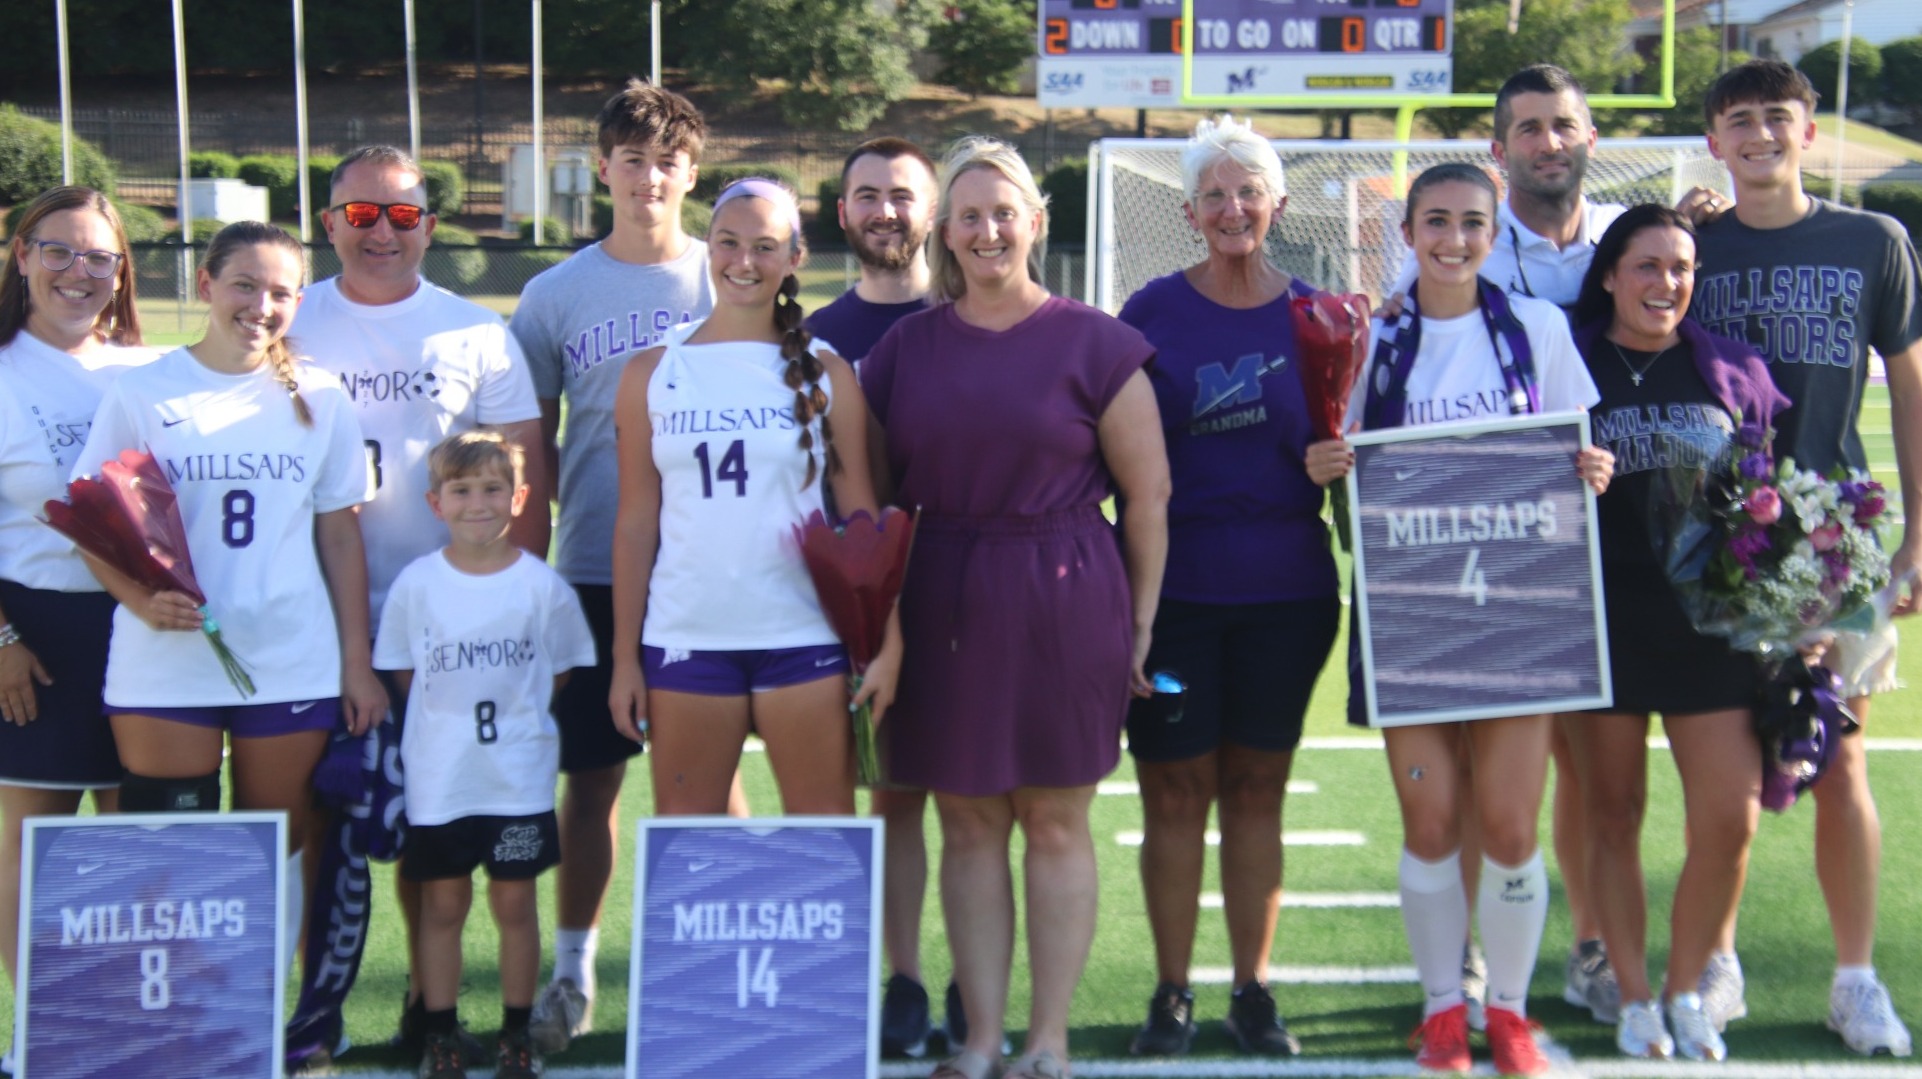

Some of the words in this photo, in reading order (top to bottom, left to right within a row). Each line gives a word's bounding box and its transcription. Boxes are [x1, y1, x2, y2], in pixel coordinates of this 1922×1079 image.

[1046, 19, 1068, 54] 2
[1071, 20, 1140, 49] DOWN
[1197, 19, 1230, 49] TO
[1237, 19, 1271, 49] GO
[1282, 19, 1317, 48] ON
[1341, 17, 1365, 53] 0
[1374, 18, 1421, 50] QTR
[657, 407, 797, 436] MILLSAPS
[1190, 406, 1267, 436] GRANDMA
[1595, 403, 1733, 446] MILLSAP
[166, 453, 305, 485] MILLSAPS
[694, 439, 748, 499] 14
[222, 489, 255, 549] 8
[1385, 500, 1558, 548] MILLSAPS
[1460, 548, 1487, 606] 4
[430, 638, 519, 674] SENOR
[475, 700, 498, 746] 8
[60, 900, 245, 946] MILLSAPS
[673, 902, 845, 942] MILLSAPS
[140, 948, 169, 1010] 8
[737, 947, 780, 1008] 14
